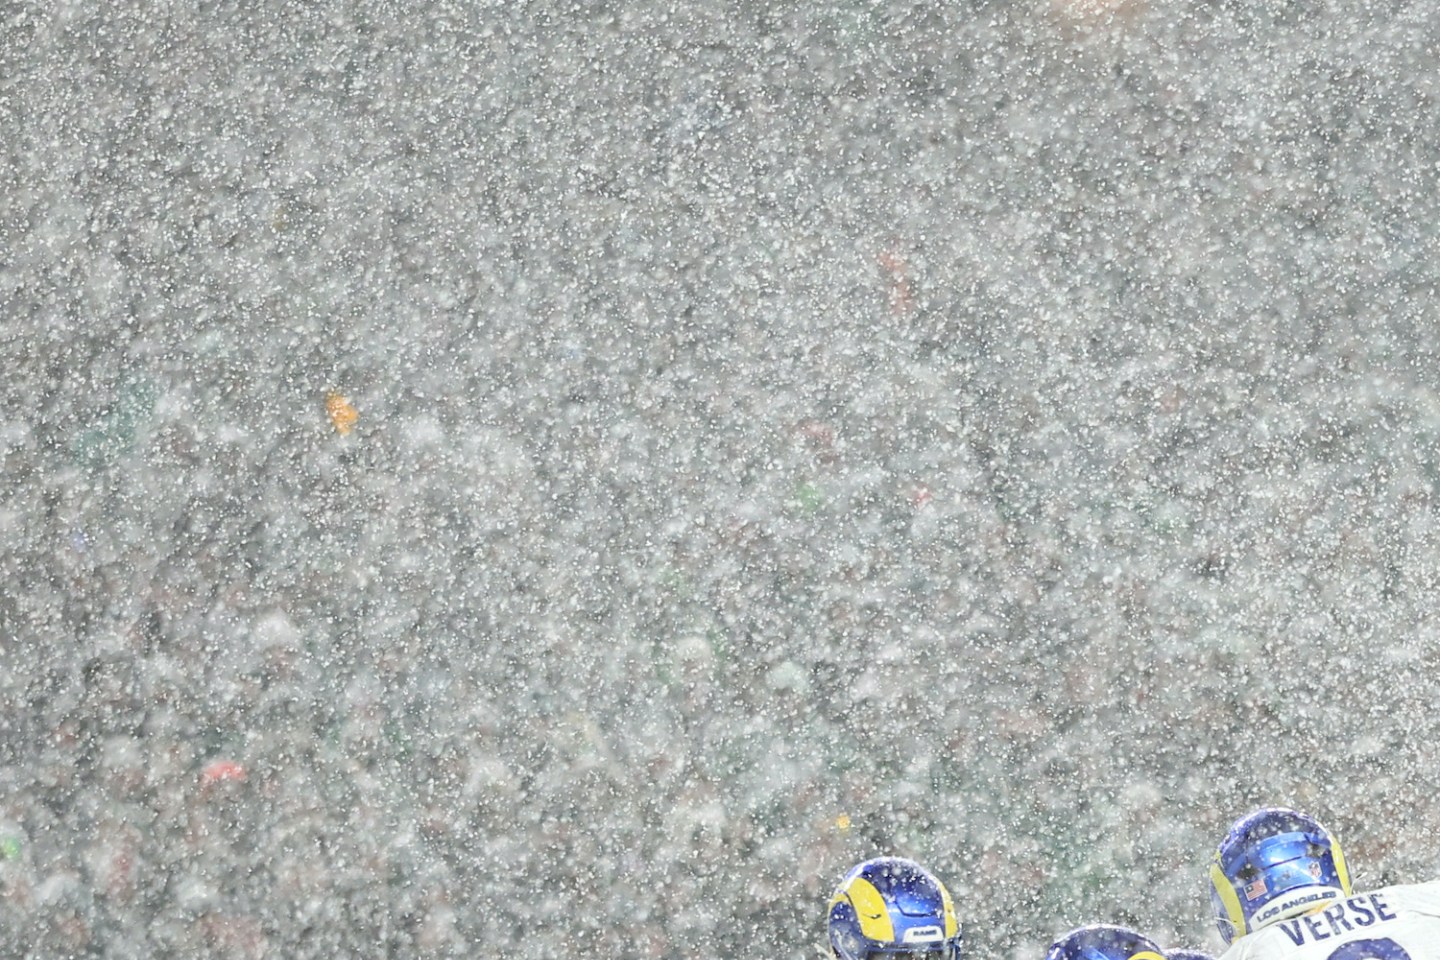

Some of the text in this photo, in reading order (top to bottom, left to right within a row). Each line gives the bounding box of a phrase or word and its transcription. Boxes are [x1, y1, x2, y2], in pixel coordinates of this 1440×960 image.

[1256, 890, 1338, 922] LOS ANGELES
[1276, 893, 1397, 947] VERSE
